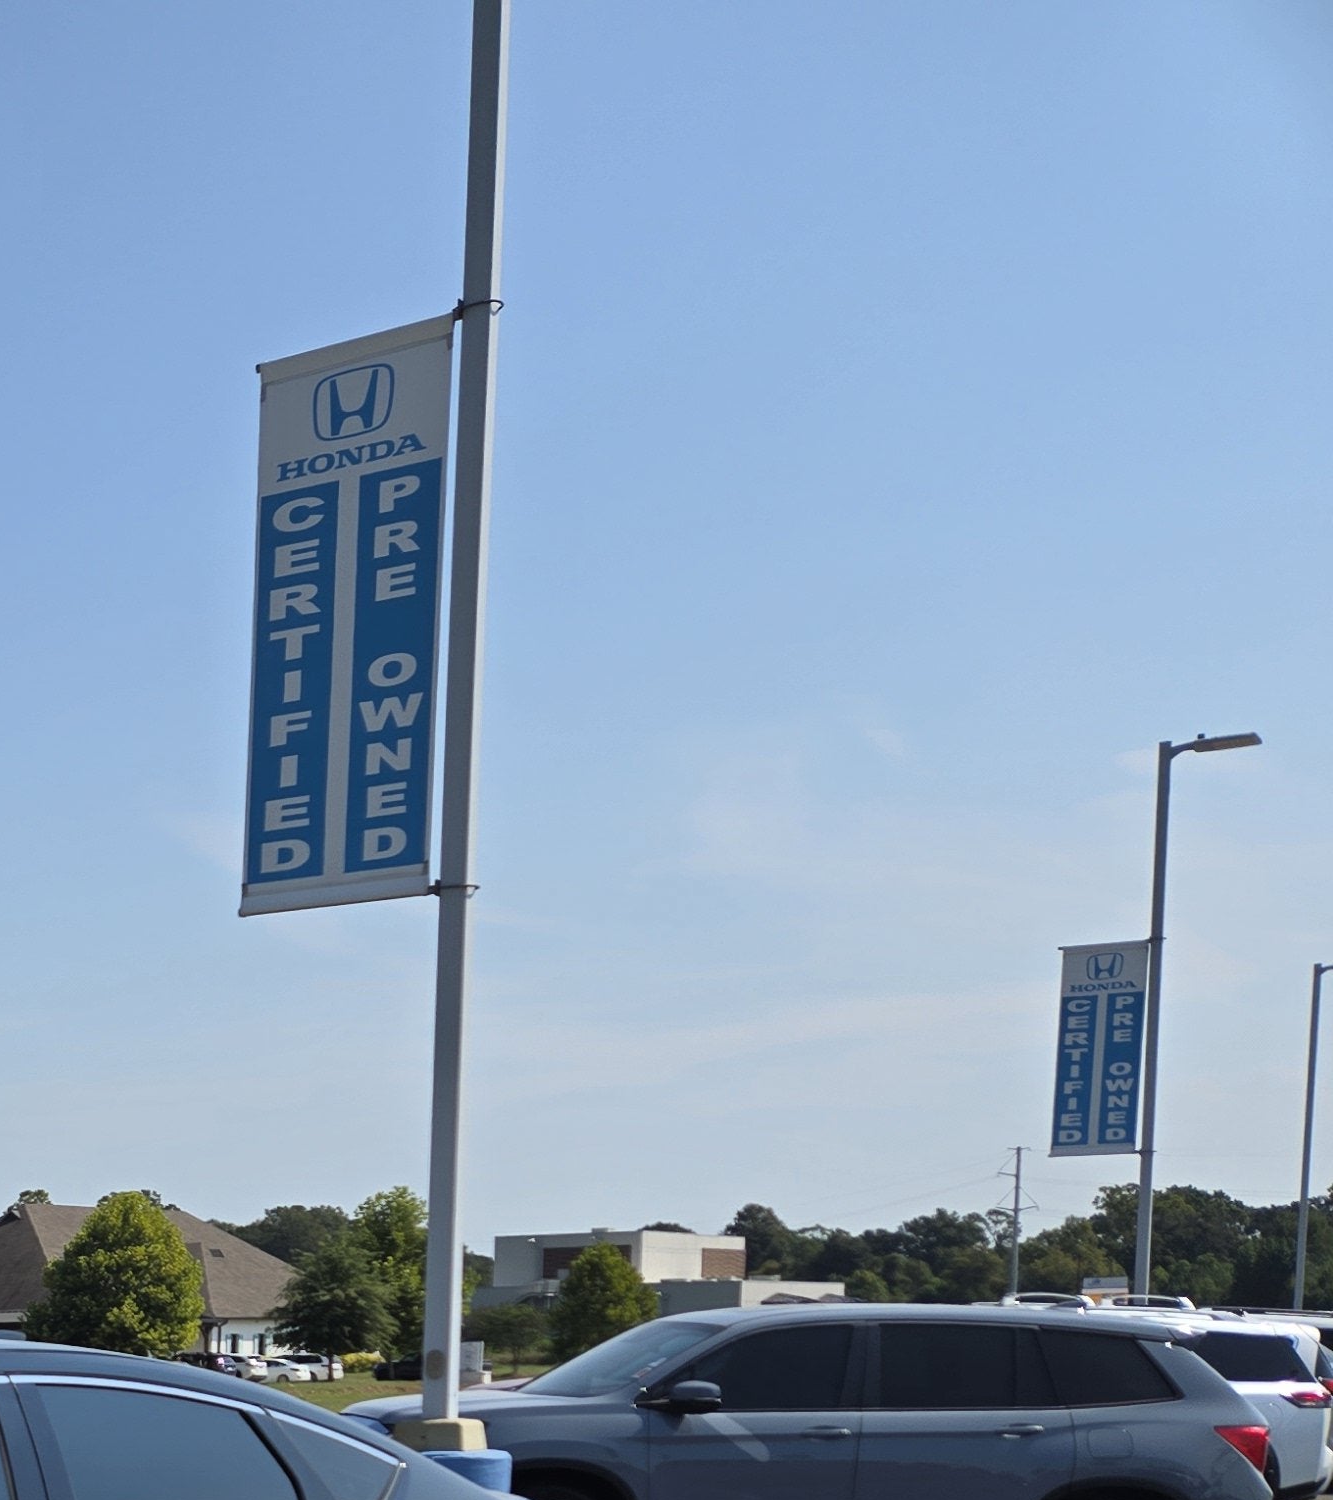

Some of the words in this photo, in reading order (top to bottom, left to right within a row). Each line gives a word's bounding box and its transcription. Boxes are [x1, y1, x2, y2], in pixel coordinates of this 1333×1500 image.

[276, 433, 427, 483] HONDA
[373, 475, 422, 602] PRE
[260, 496, 326, 875] CERTIFIED
[358, 652, 424, 862] OWNED
[1069, 981, 1137, 993] HONDA
[1113, 995, 1135, 1043] PRE
[1058, 999, 1092, 1144] CERTIFIED
[1104, 1062, 1135, 1142] OWNED
